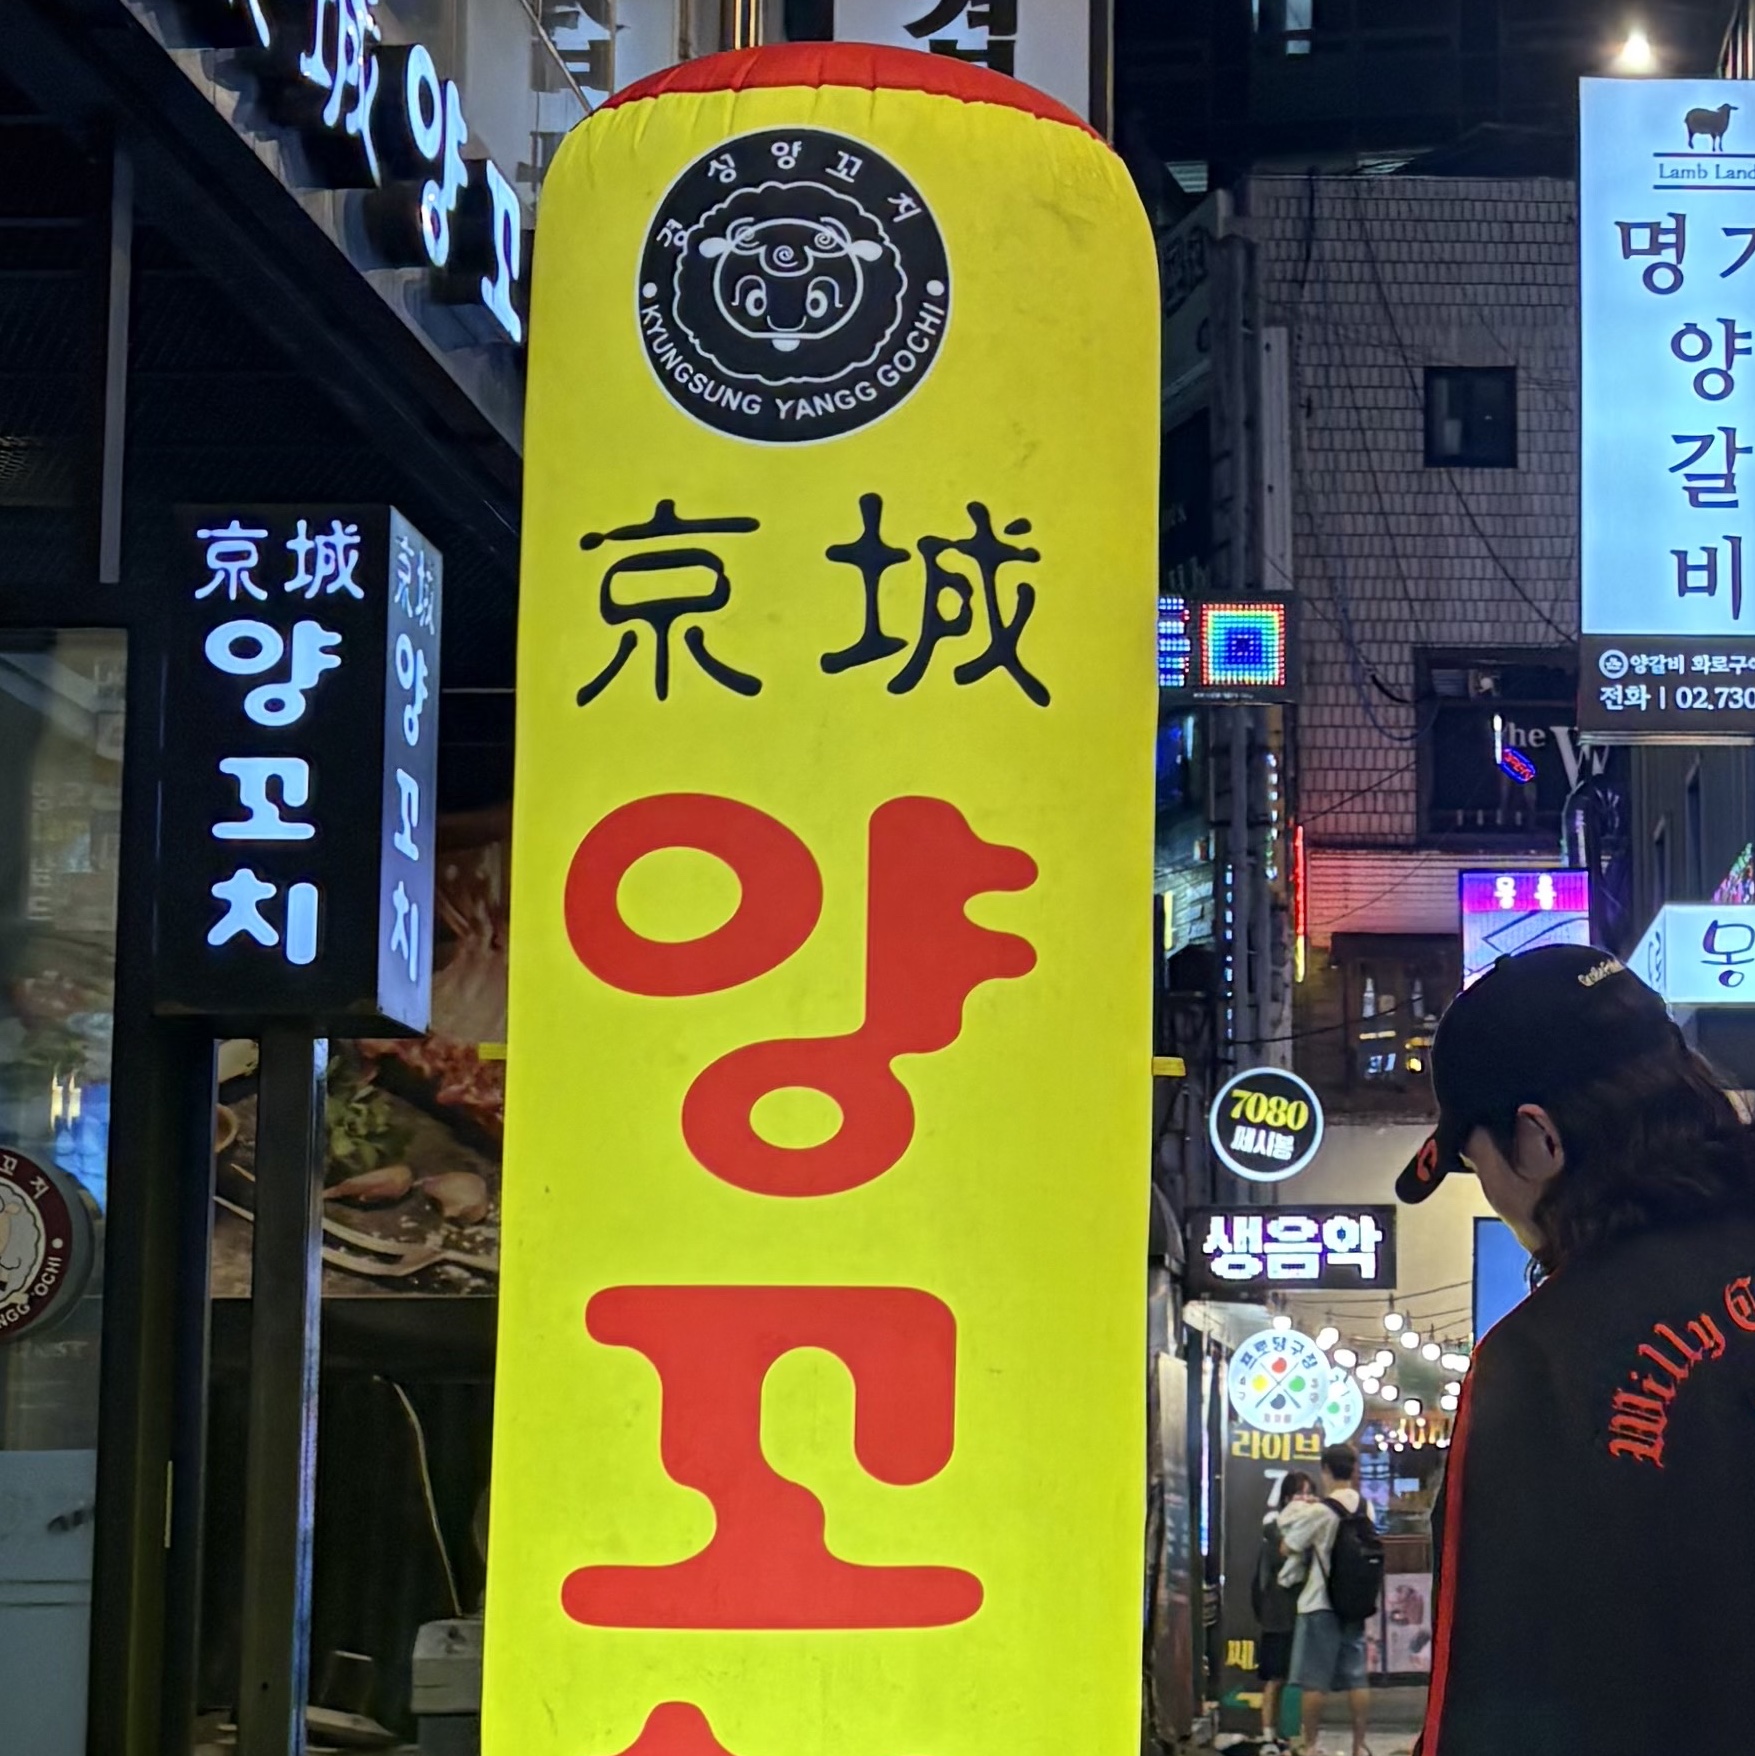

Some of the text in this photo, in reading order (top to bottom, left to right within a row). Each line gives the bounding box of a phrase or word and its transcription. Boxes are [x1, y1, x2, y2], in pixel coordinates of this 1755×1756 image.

[1658, 163, 1708, 181] Lamb
[642, 302, 945, 421] KYUNGSUNG YANGG GOCHI
[195, 520, 364, 600] 京城
[577, 493, 1050, 707] 京城
[1630, 654, 1685, 676] 양갈비
[1600, 685, 1651, 711] 전화
[1503, 722, 1547, 747] he
[1230, 1088, 1309, 1131] 7080
[1202, 1215, 1383, 1279] 생음악
[1608, 1313, 1726, 1468] Willy
[1231, 1430, 1321, 1461] 라이브
